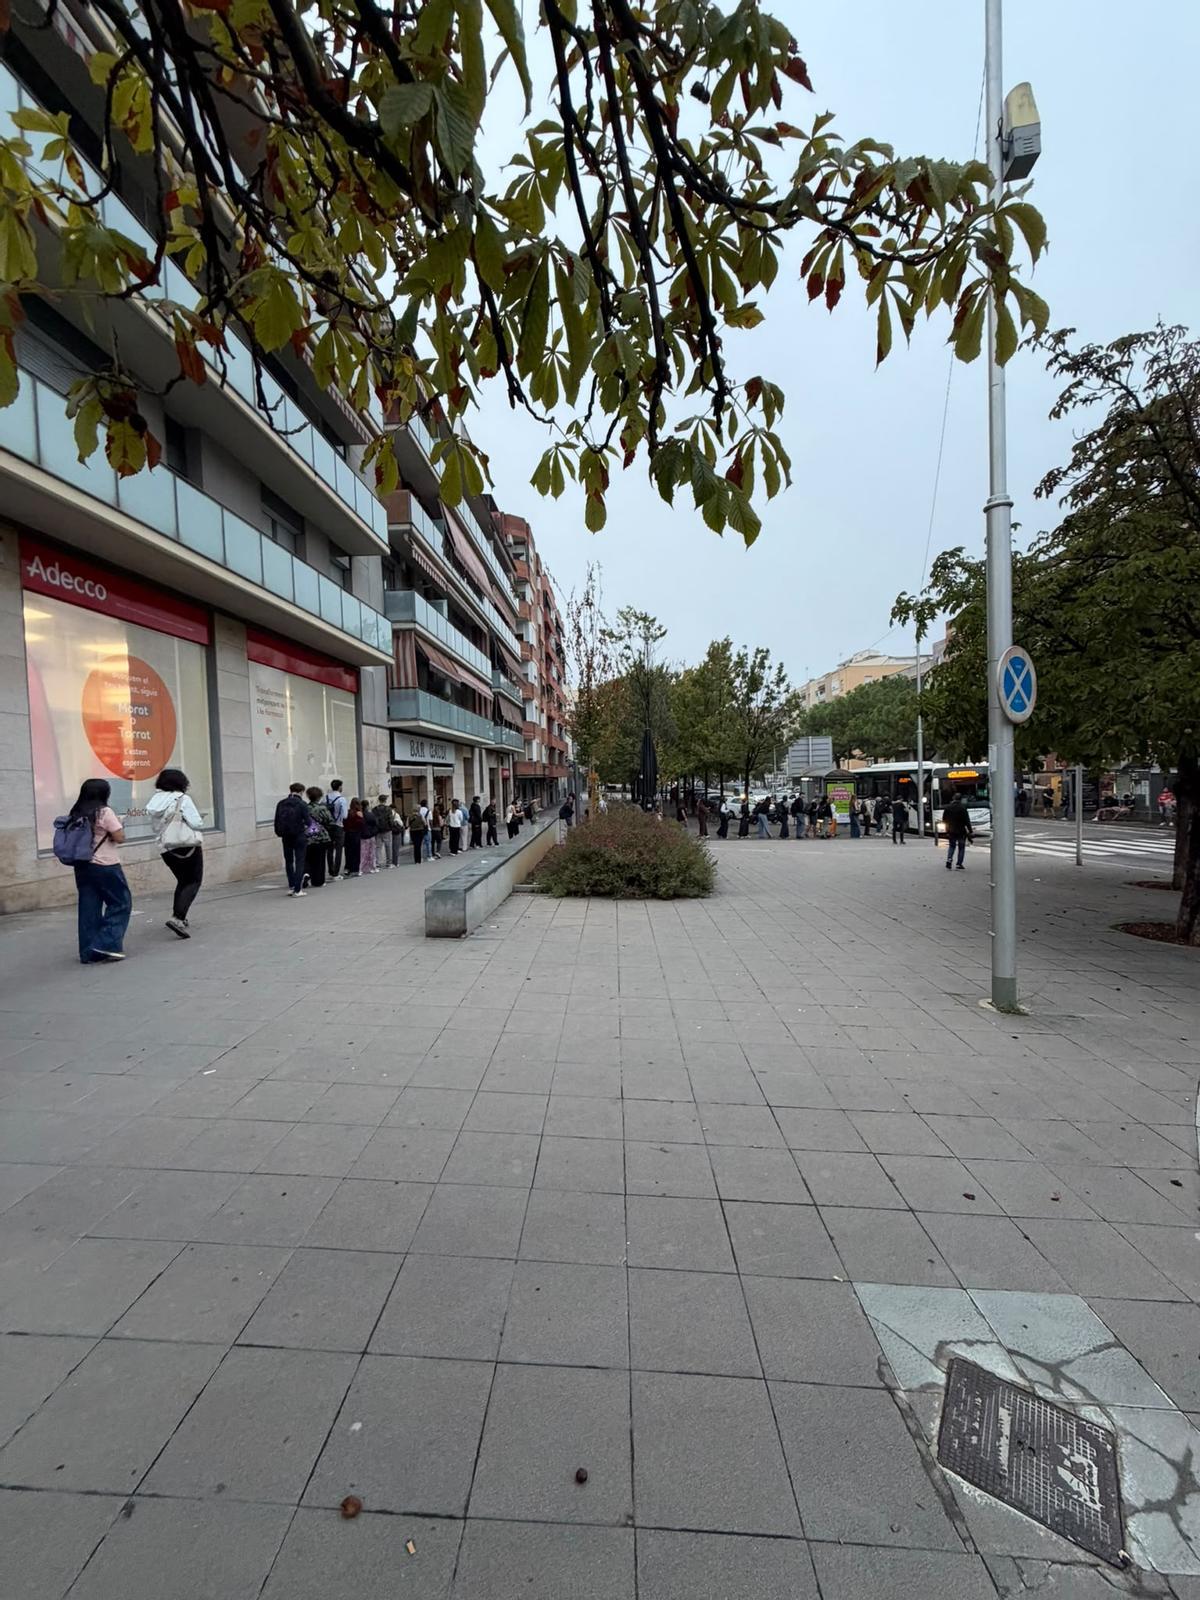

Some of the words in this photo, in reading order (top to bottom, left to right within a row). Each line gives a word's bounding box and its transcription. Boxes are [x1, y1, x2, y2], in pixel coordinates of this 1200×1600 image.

[26, 555, 107, 601] Adecco
[118, 703, 149, 716] Morat
[118, 726, 151, 740] Torrat
[410, 739, 426, 758] BAR
[127, 808, 150, 817] Adecc
